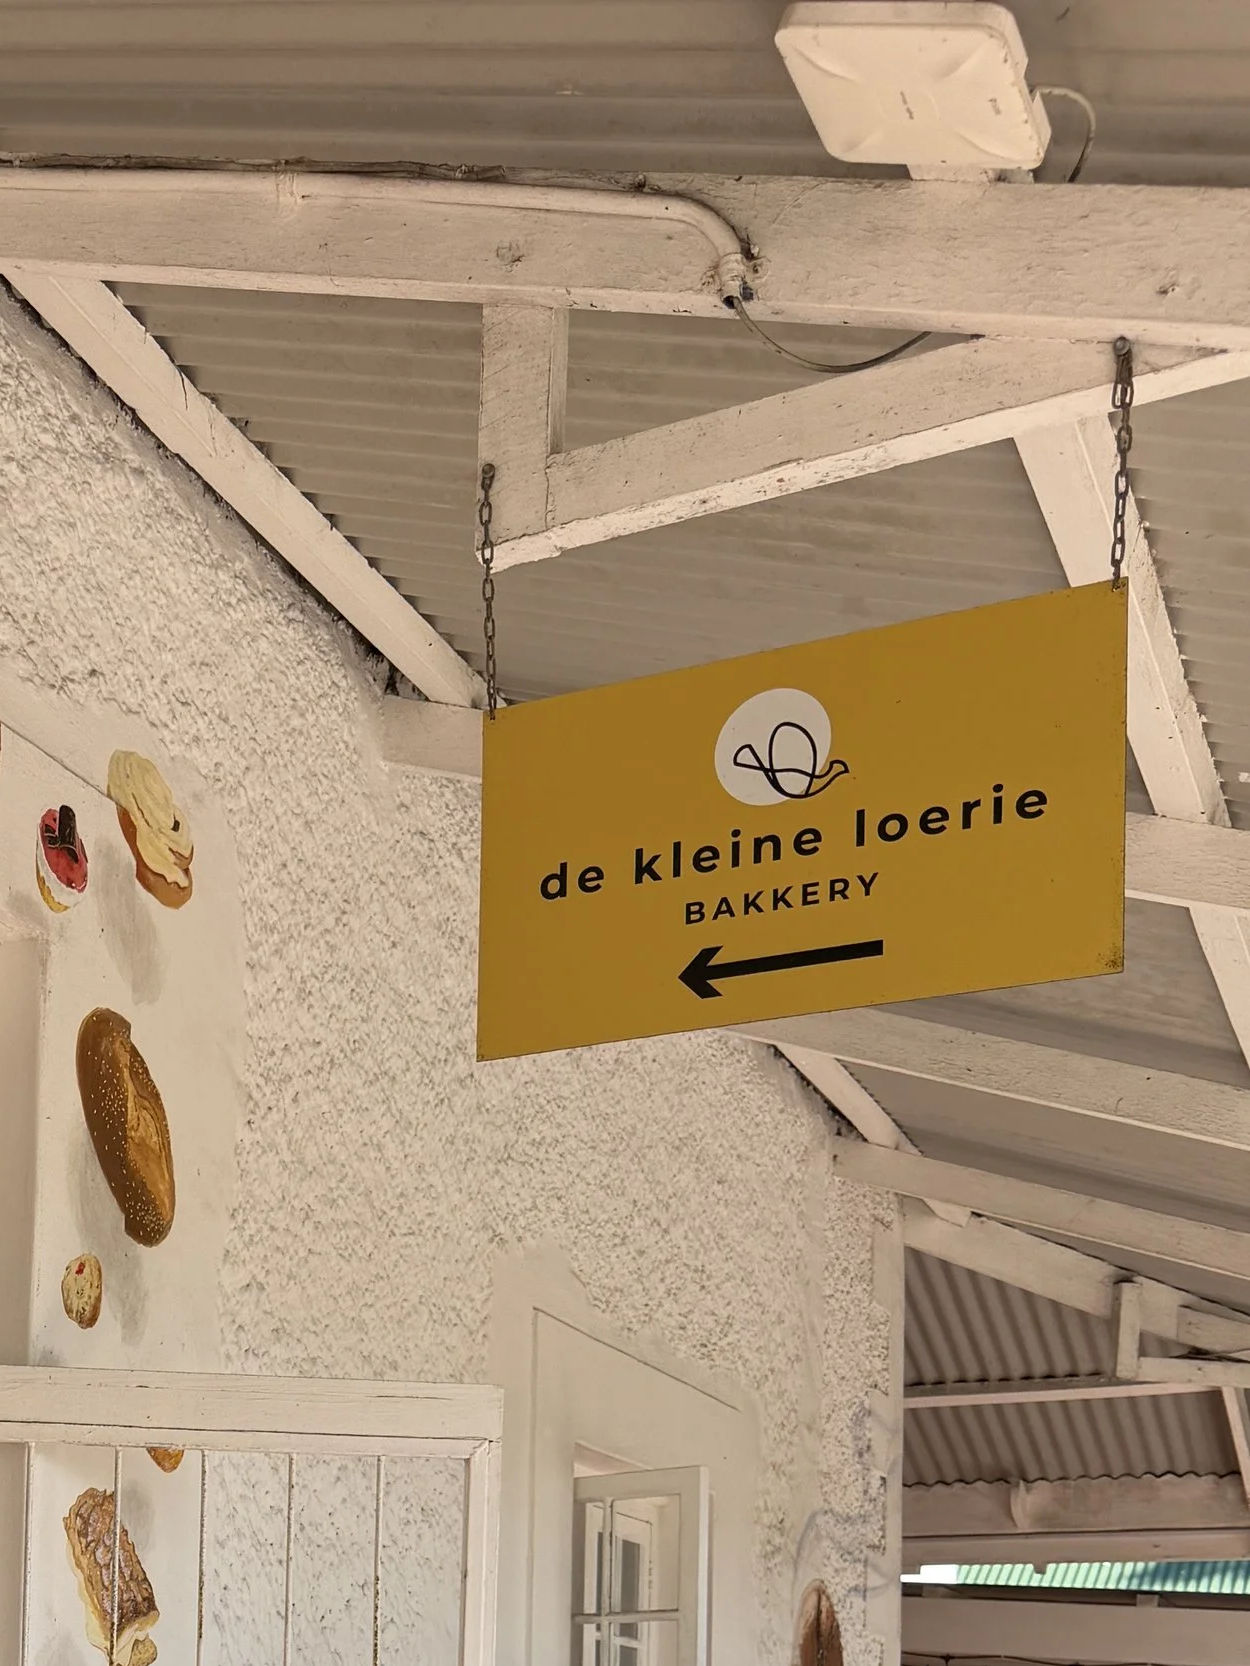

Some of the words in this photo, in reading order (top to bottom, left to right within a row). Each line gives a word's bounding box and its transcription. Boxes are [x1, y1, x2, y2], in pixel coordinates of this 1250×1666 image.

[540, 860, 605, 901] de
[634, 827, 823, 885] kleine
[855, 782, 1049, 847] loerie
[684, 871, 880, 925] BAKKERY
